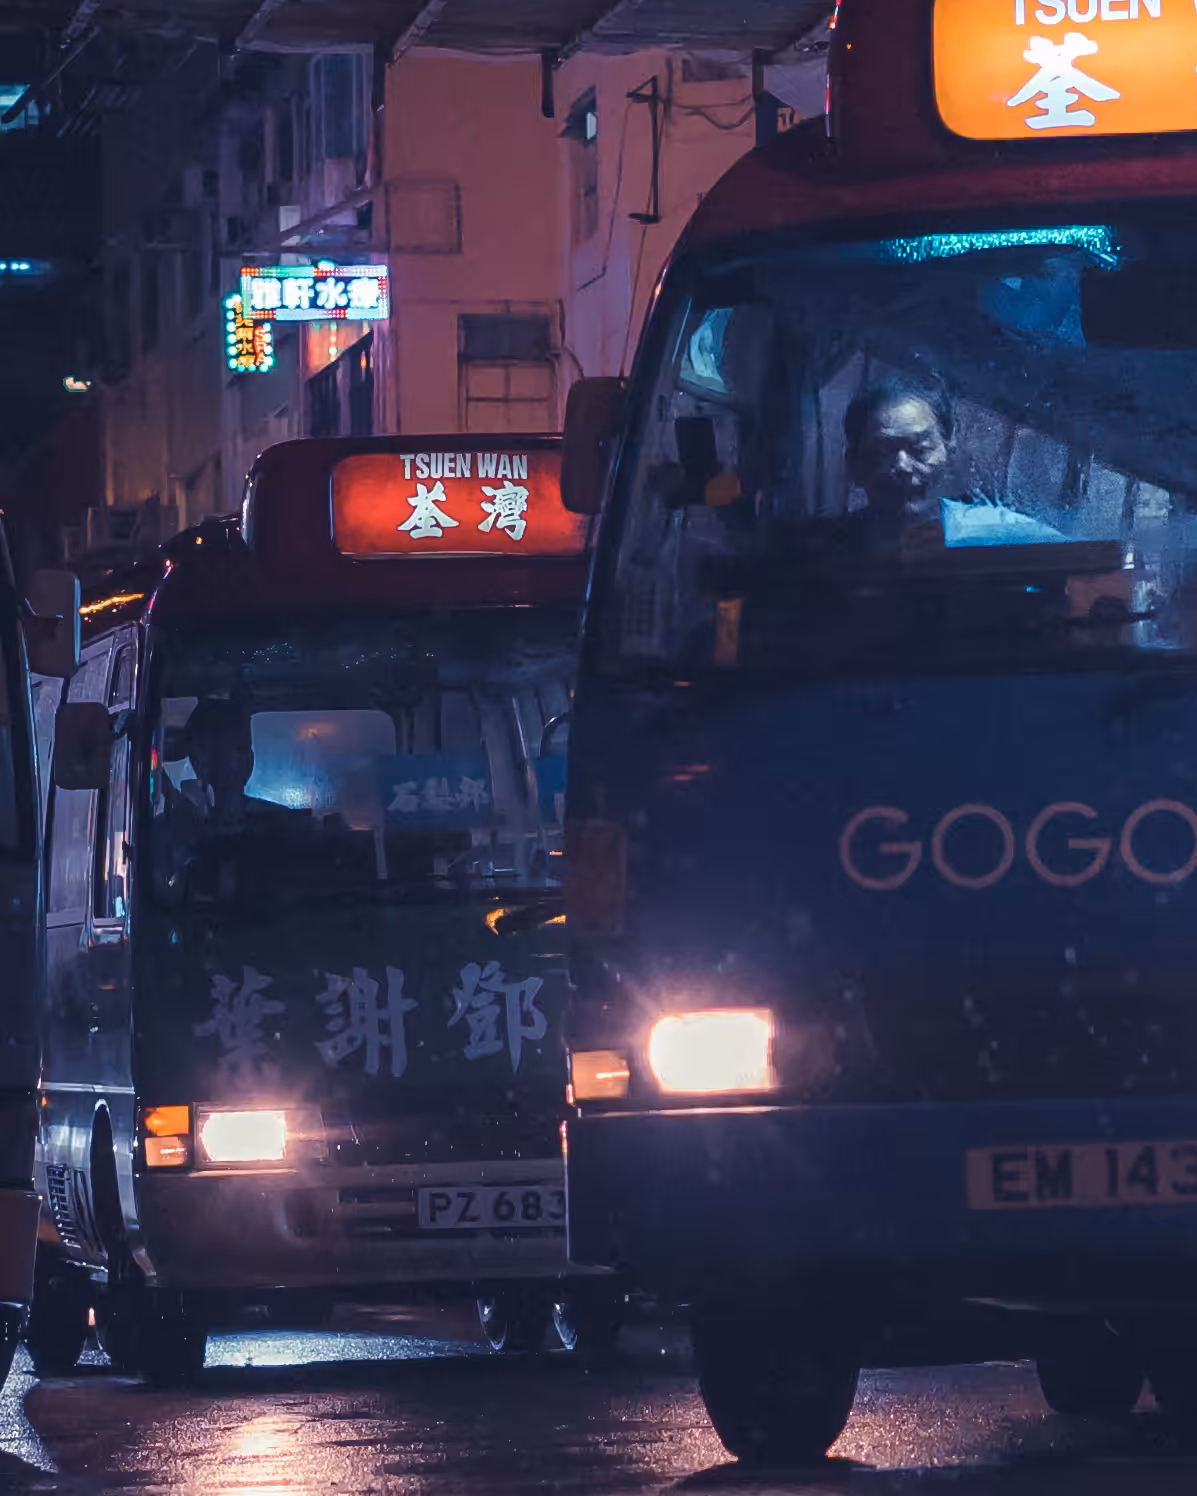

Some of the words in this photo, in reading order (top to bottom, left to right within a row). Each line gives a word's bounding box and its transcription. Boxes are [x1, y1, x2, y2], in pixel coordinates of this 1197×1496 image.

[400, 453, 471, 479] TSUEN
[477, 453, 528, 479] WAN
[397, 481, 529, 541] 荃灣
[992, 1150, 1073, 1203] EM
[429, 1191, 481, 1223] PZ
